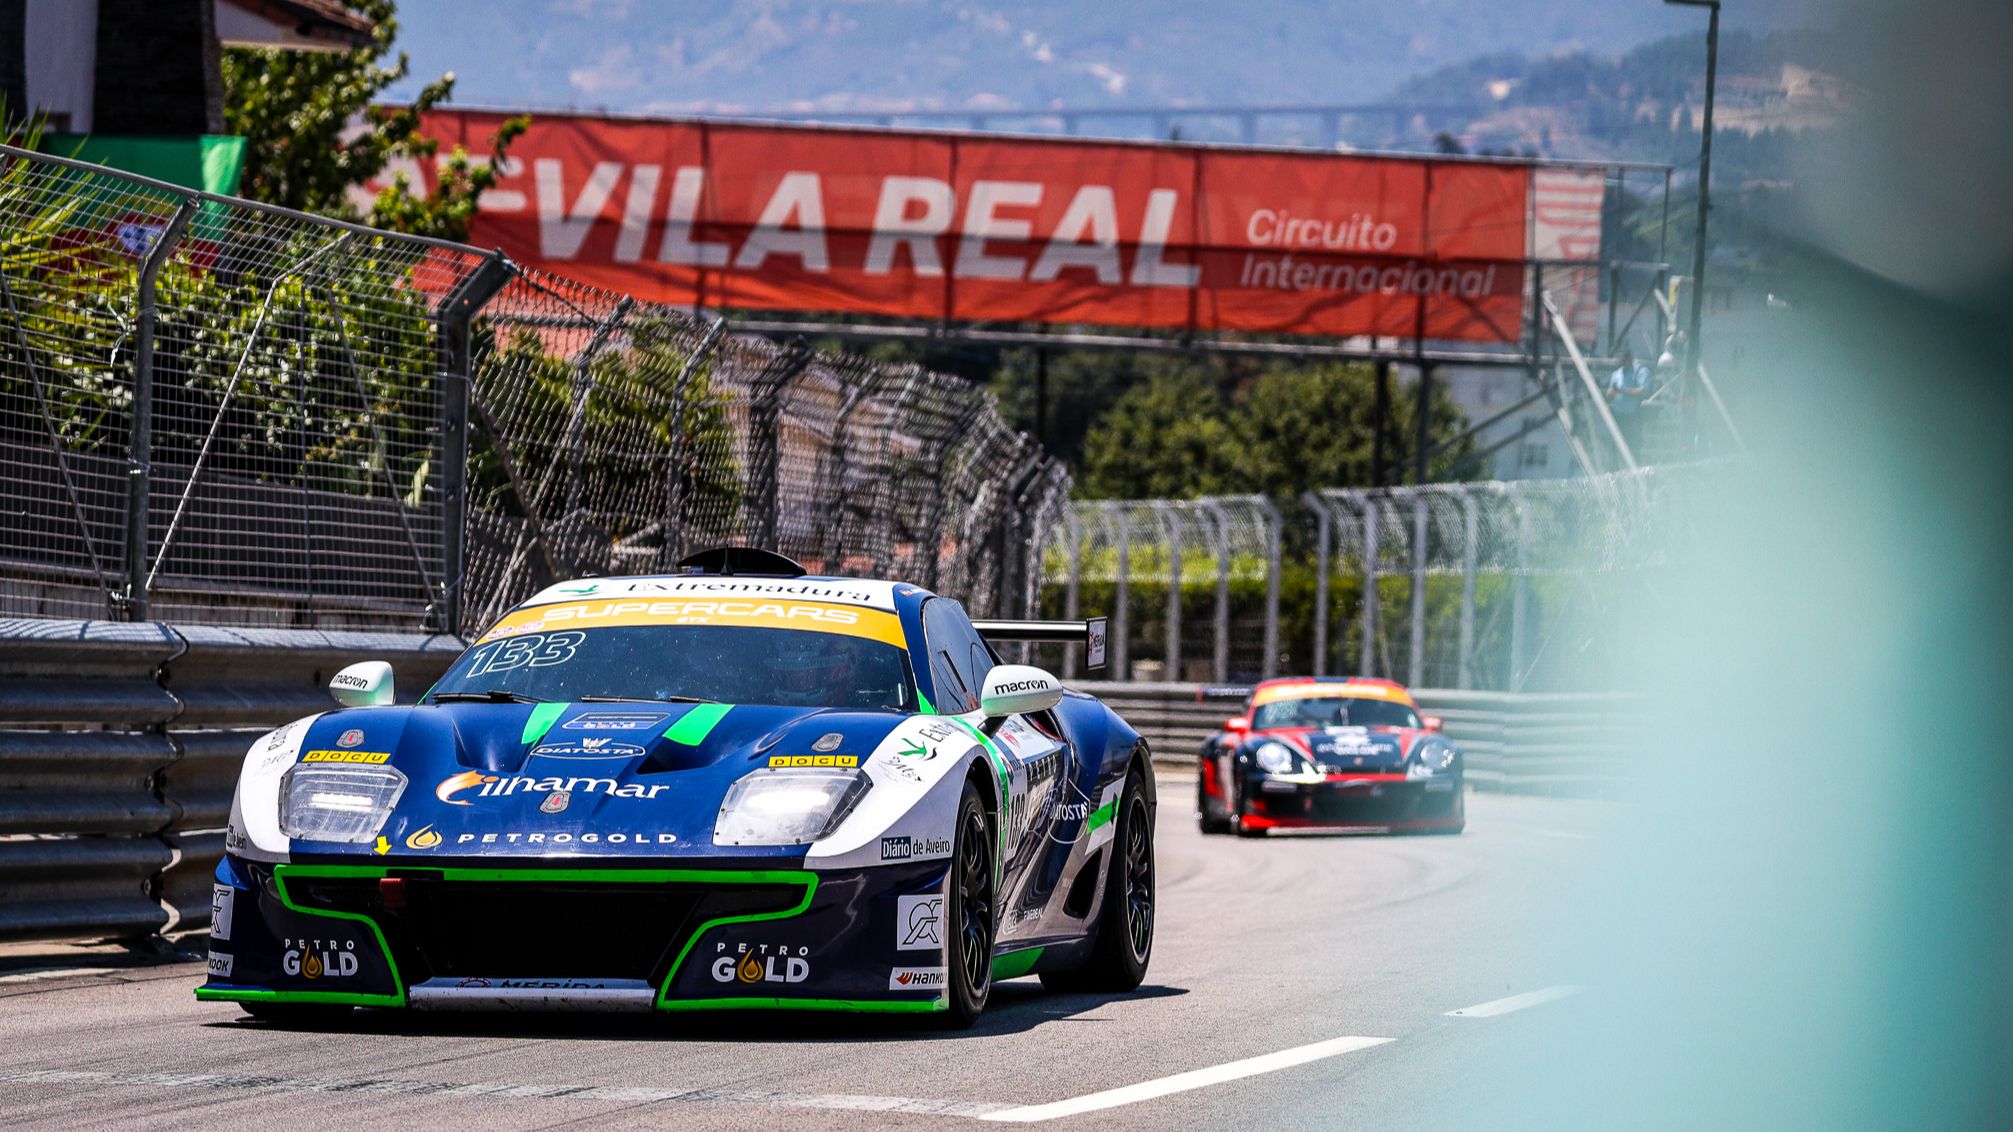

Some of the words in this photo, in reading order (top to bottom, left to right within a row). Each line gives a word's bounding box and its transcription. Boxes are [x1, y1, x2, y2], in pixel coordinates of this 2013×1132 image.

[534, 159, 830, 272] VILA
[863, 175, 1201, 288] REAL
[1246, 208, 1397, 250] Circuito
[1240, 253, 1496, 298] Internacional
[627, 582, 872, 602] Extremadura
[542, 601, 861, 625] SUPERCARS
[465, 631, 587, 679] 133
[333, 675, 369, 689] macron
[994, 680, 1049, 695] macron
[309, 753, 383, 762] DOCU
[774, 758, 852, 766] DOCU
[457, 833, 678, 844] PETROGOLD
[882, 838, 910, 858] Diário
[913, 839, 923, 855] de
[926, 837, 950, 854] Aveiro
[285, 938, 354, 950] PETRO
[717, 942, 808, 956] PETRO
